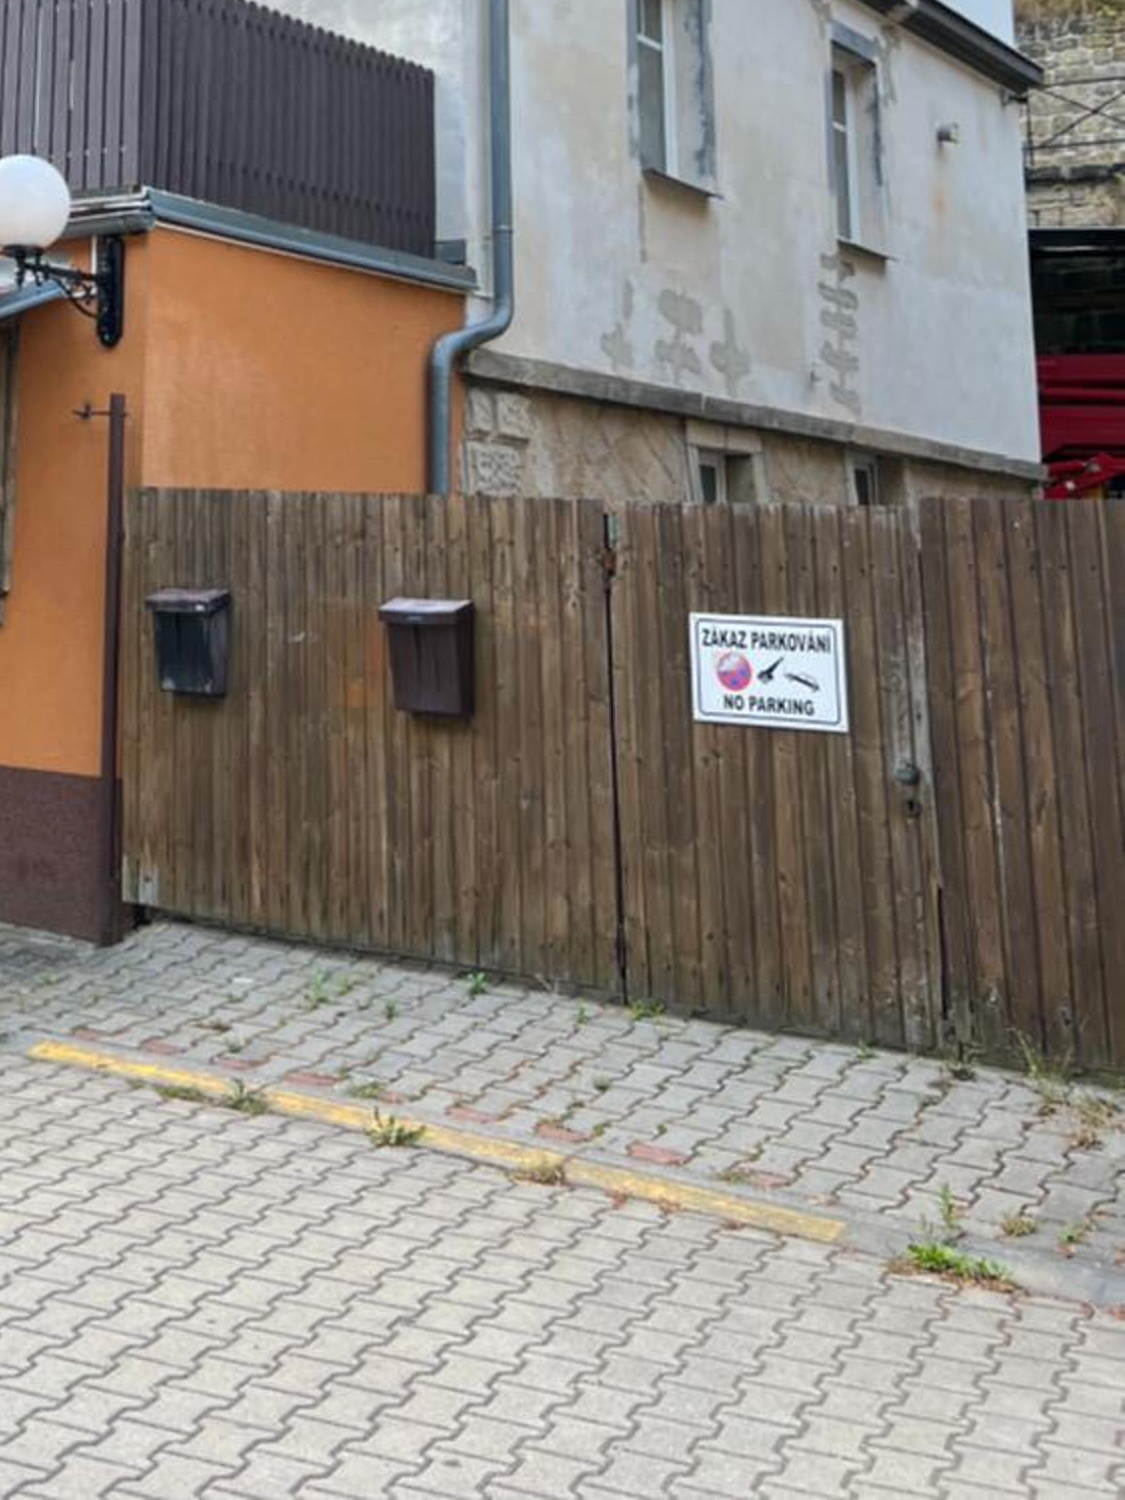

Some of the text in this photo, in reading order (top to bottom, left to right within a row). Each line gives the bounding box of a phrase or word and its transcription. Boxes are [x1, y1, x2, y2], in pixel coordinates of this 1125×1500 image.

[701, 628, 831, 653] ZÁKAZ PARKOVÁNÍ
[724, 695, 815, 716] NO PARKING
